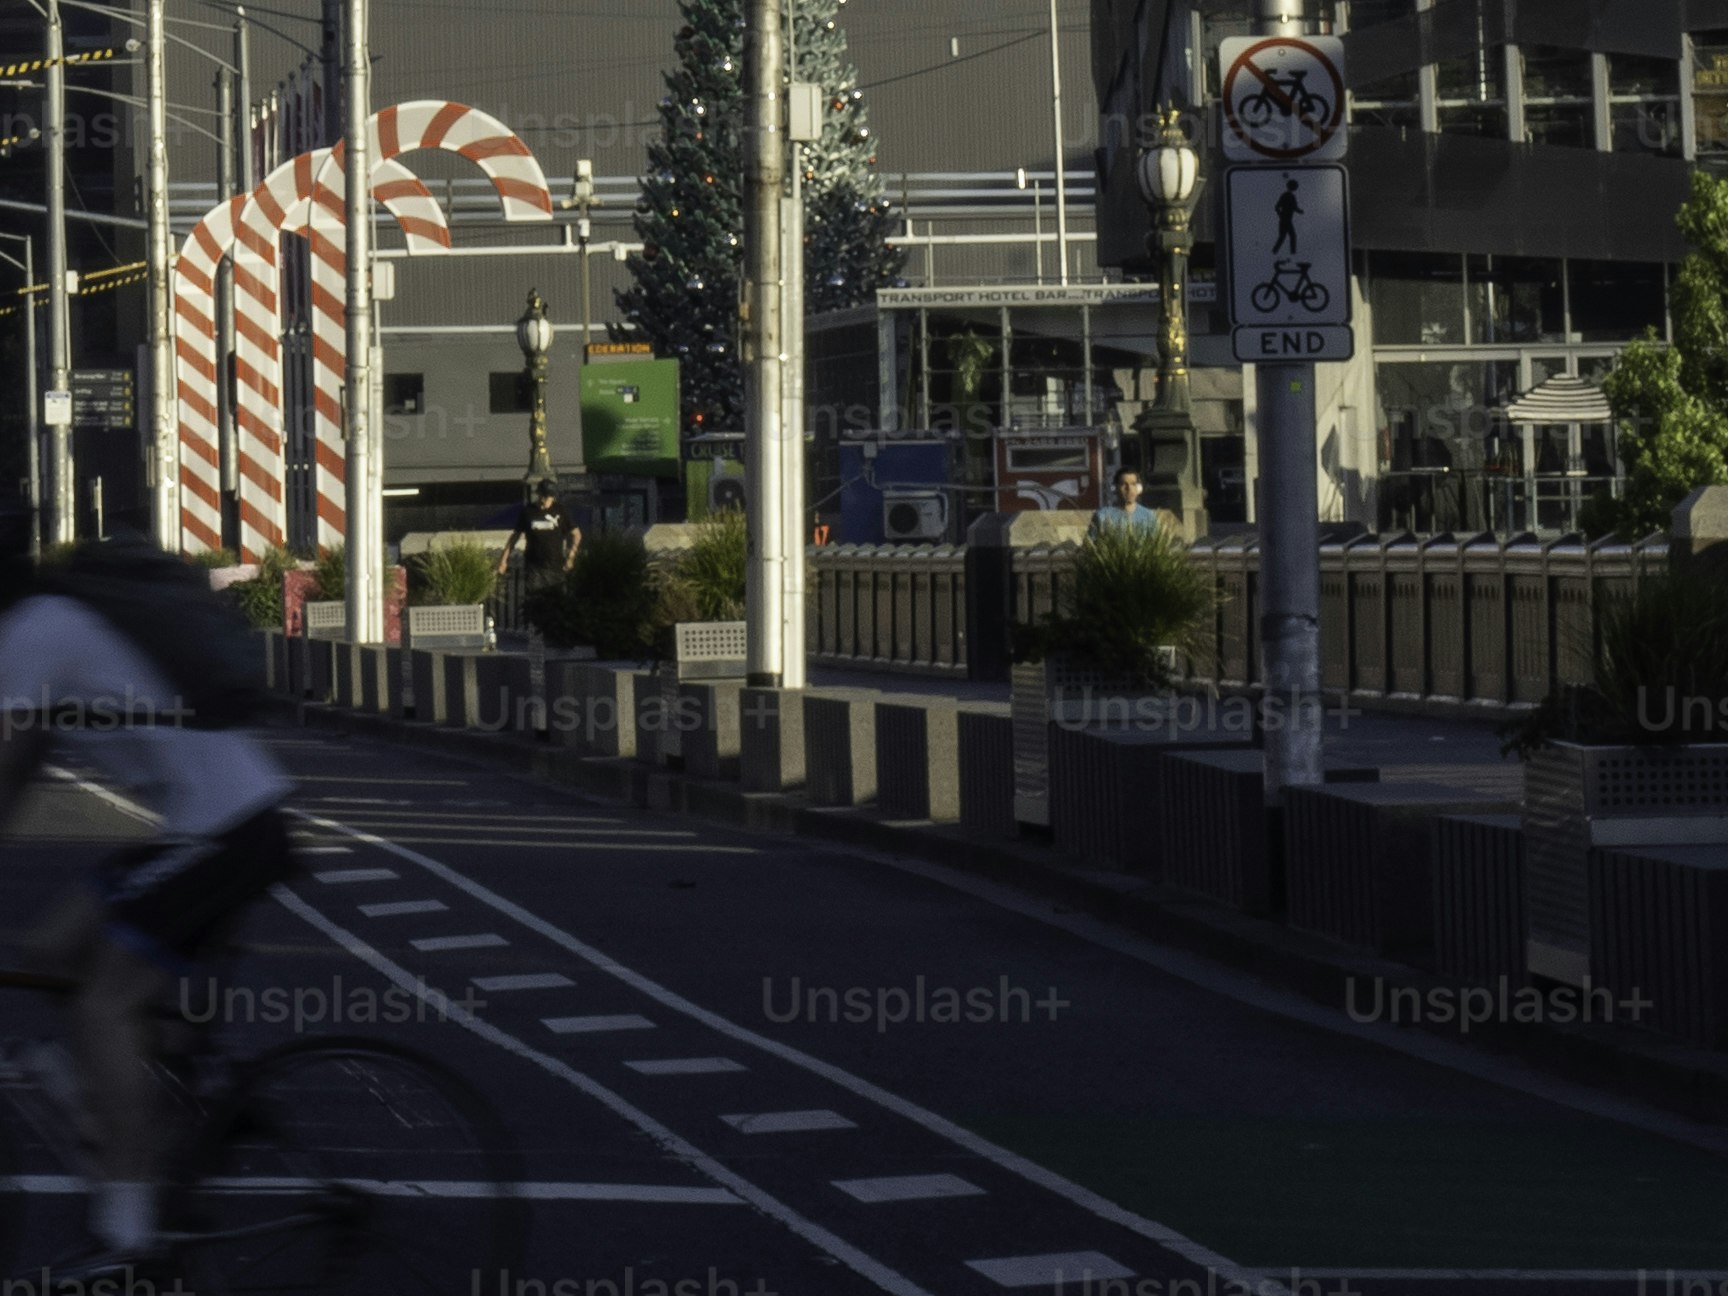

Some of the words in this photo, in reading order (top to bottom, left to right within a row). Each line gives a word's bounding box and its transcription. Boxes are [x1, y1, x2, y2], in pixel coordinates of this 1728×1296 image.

[879, 293, 974, 303] TRANSPORT
[979, 291, 1030, 302] HOTEL
[1035, 290, 1067, 300] BAR
[1086, 289, 1159, 300] TRANSPO
[1260, 331, 1325, 353] END
[691, 442, 735, 458] CRUISE
